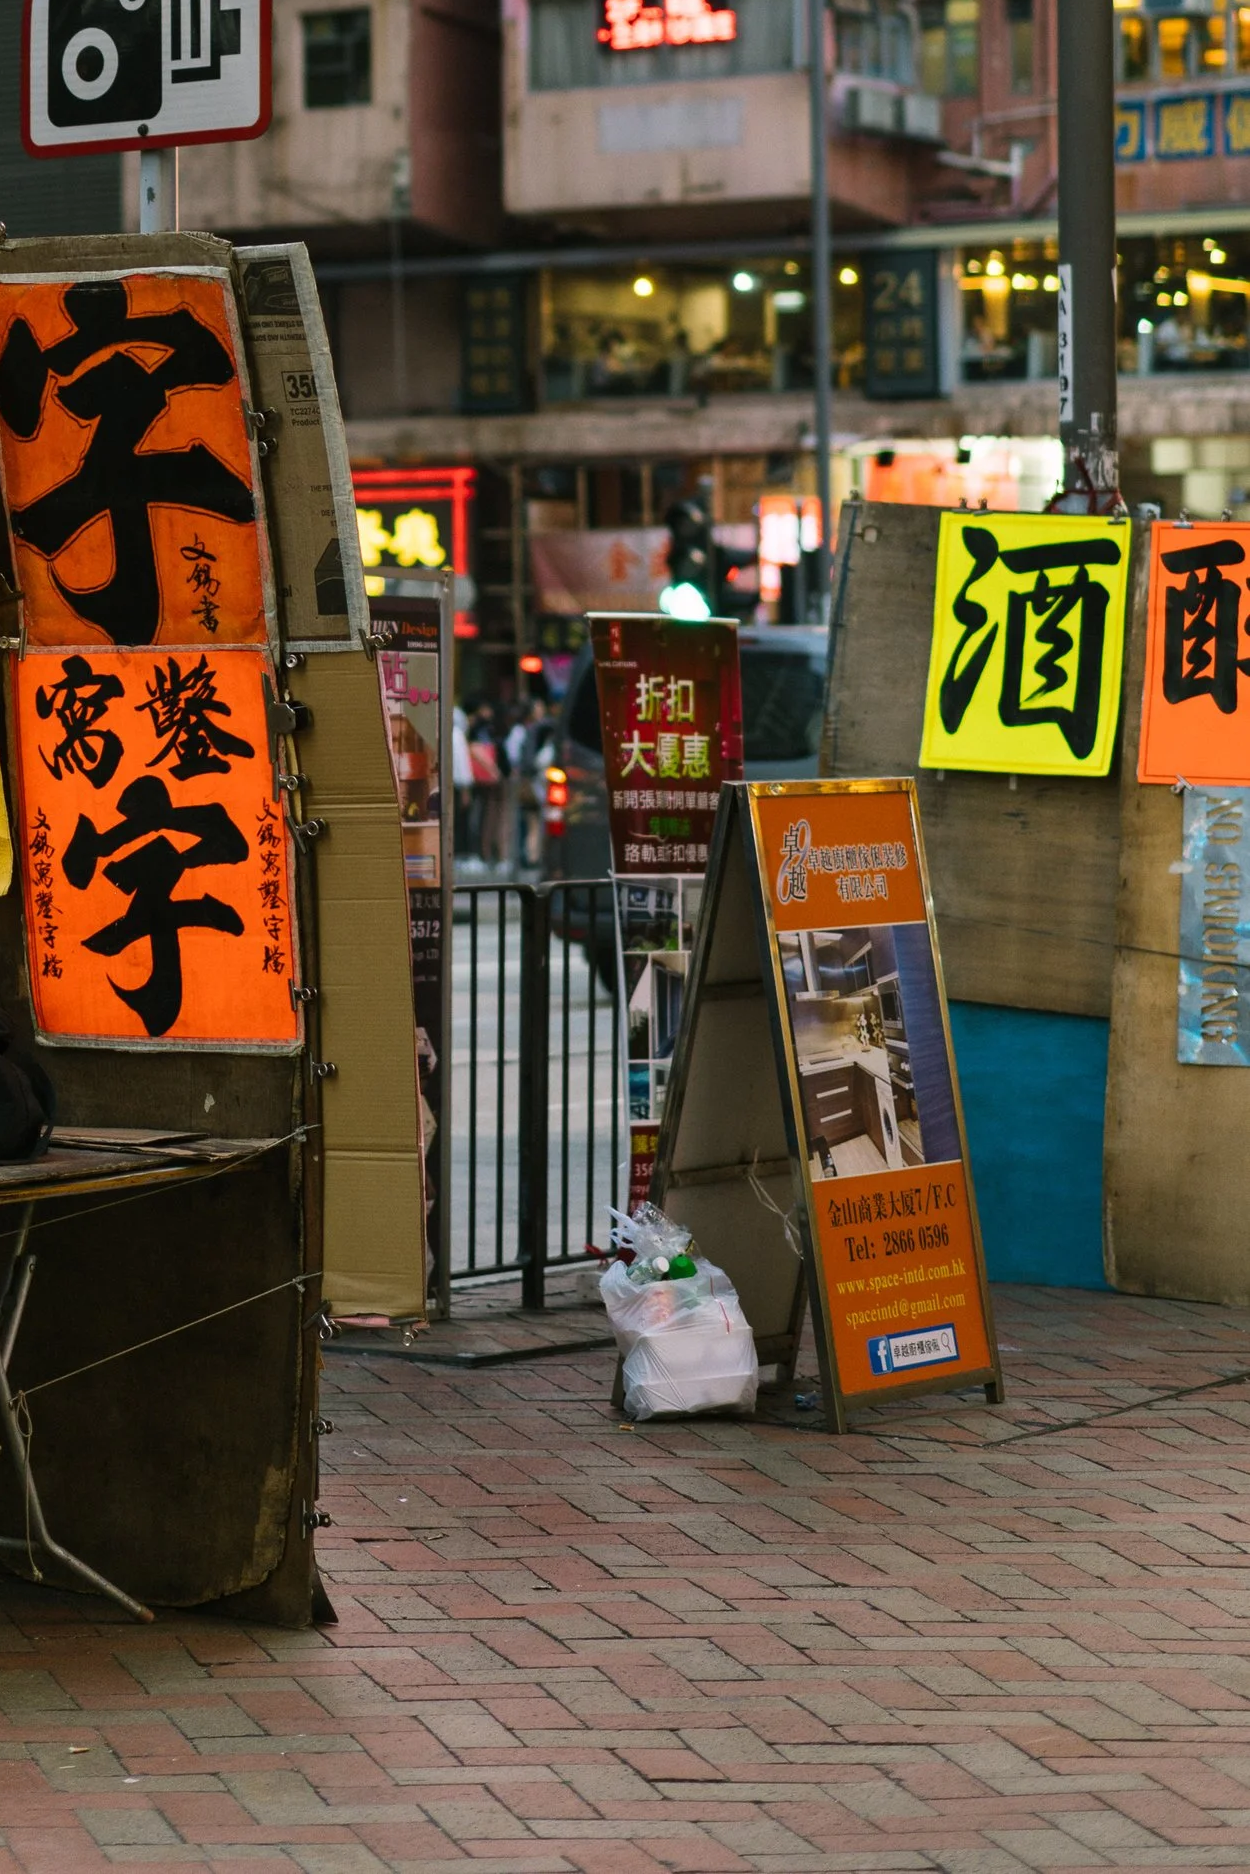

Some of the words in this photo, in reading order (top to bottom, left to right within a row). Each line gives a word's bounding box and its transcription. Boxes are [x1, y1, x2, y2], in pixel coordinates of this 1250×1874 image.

[291, 418, 320, 427] Product
[943, 526, 1121, 760] 酒
[636, 674, 695, 723] 折扣
[620, 729, 711, 779] 大優惠
[1206, 795, 1243, 846] NO
[61, 773, 250, 1038] 字
[837, 874, 888, 900] 有限公司
[1201, 862, 1240, 1044] SMOKING
[845, 1236, 876, 1262] Tel:
[883, 1229, 915, 1257] 2866
[918, 1223, 949, 1248] 0596
[836, 1258, 967, 1295] www.space-intd.com.hk
[845, 1292, 966, 1330] spaceintd@gmail.com
